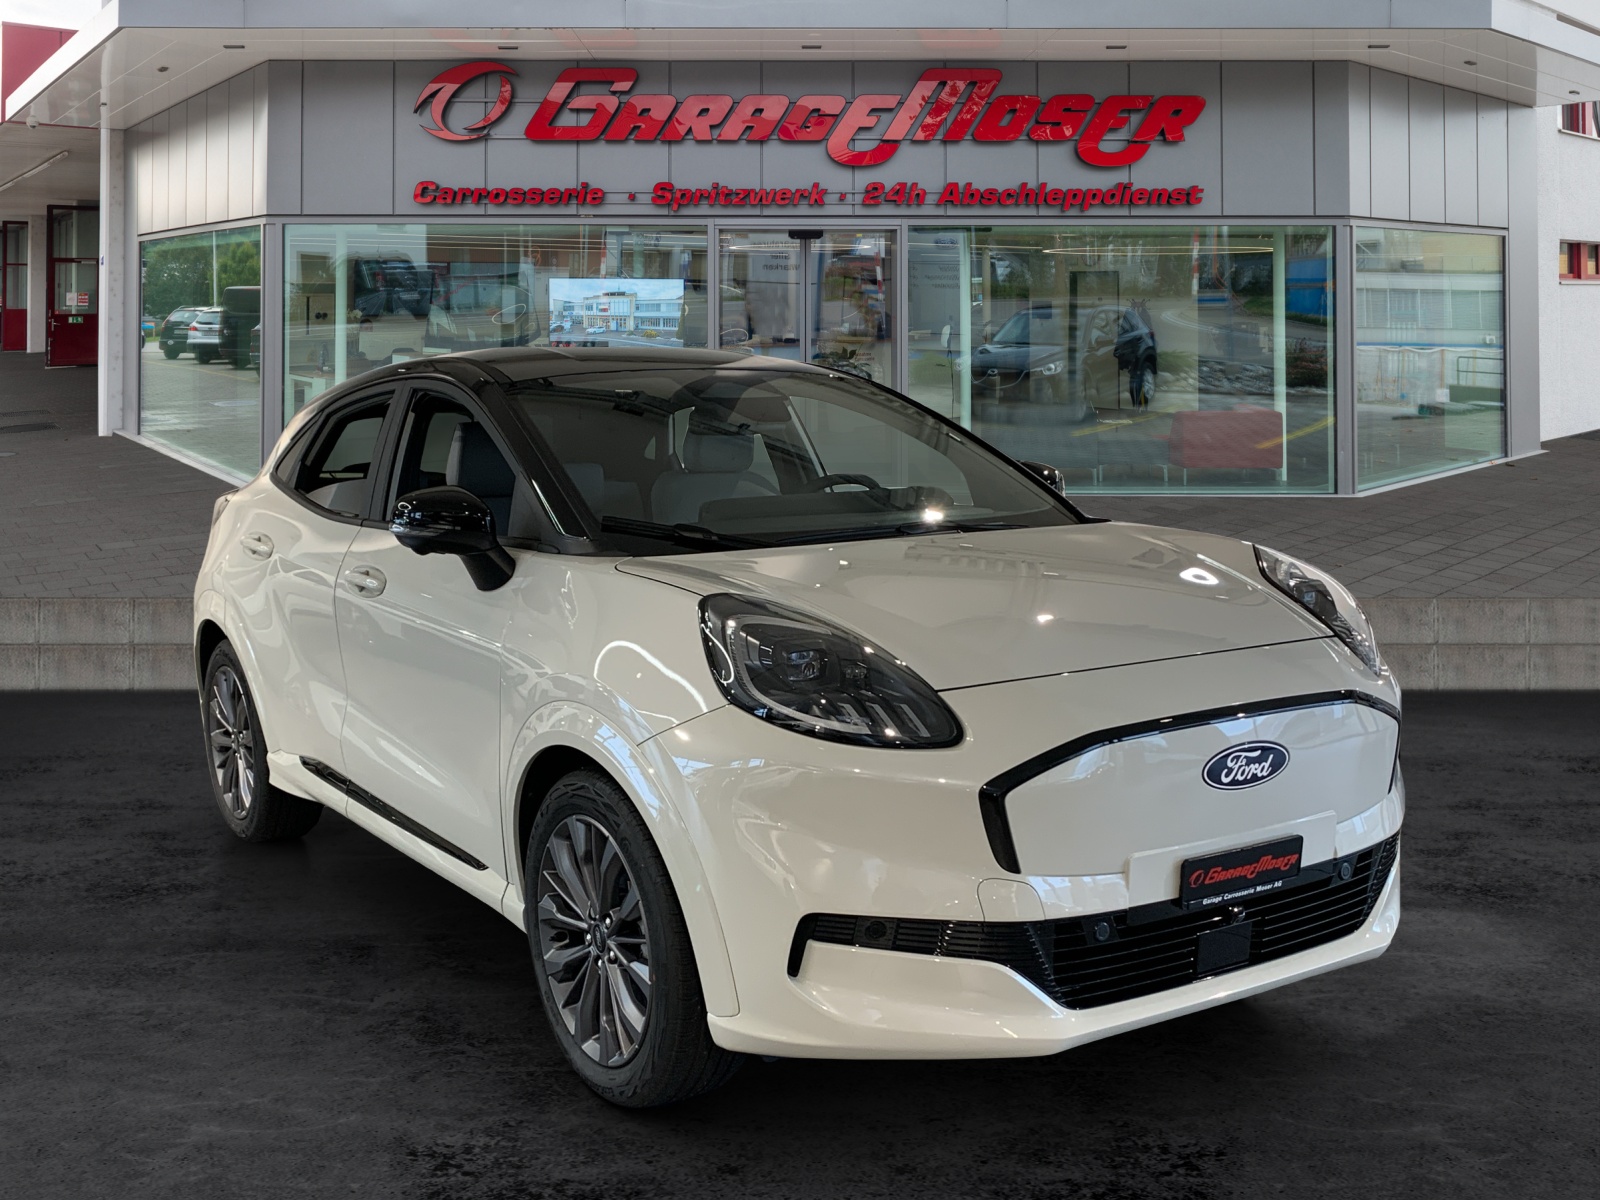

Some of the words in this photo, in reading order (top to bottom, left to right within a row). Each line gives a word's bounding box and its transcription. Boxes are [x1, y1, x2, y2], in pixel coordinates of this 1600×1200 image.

[413, 181, 605, 205] Carrosserie
[651, 182, 826, 211] Spritzwerk
[862, 182, 927, 205] 24h
[937, 182, 1204, 212] Abschleppdienst
[1220, 749, 1274, 784] Ford
[1202, 896, 1222, 905] Garage
[1223, 888, 1255, 900] Carrosserie
[1255, 884, 1273, 892] Moser
[1274, 880, 1283, 888] AG
